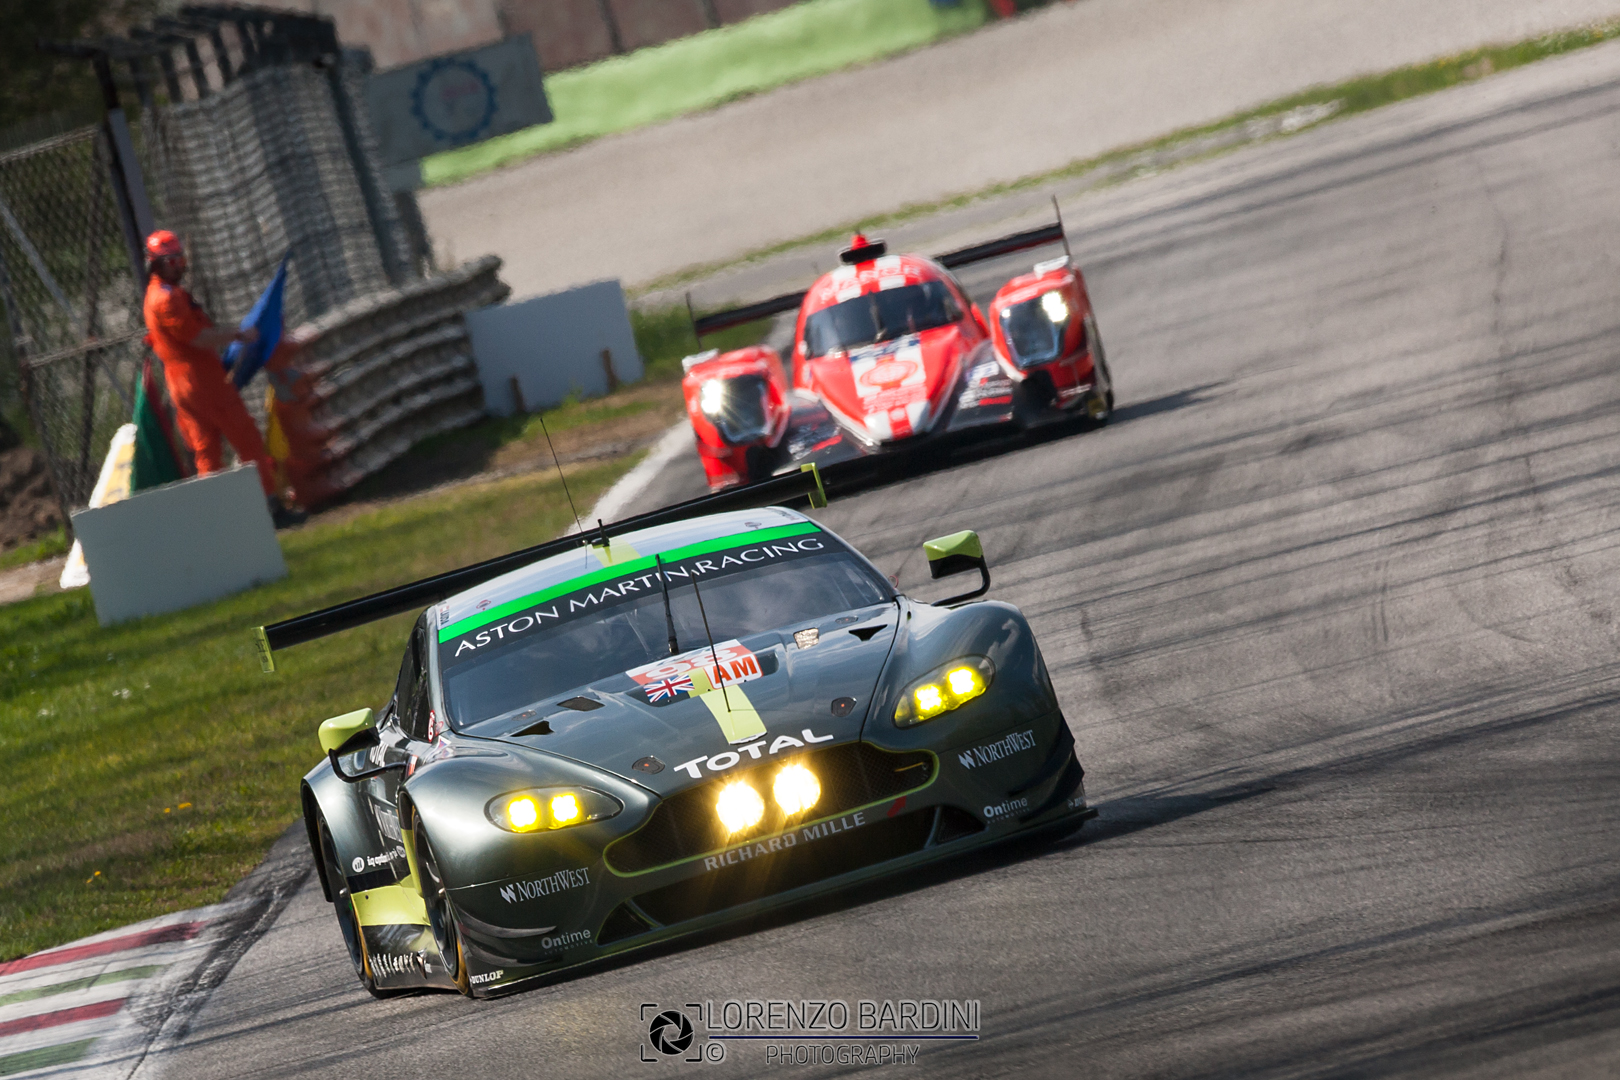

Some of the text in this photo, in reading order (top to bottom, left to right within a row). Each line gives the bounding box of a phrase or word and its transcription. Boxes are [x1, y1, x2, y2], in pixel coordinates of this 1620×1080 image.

[454, 538, 825, 658] ASTON MARTIN RACING
[645, 649, 738, 681] 98
[712, 656, 758, 685] AM
[673, 728, 835, 780] TOTAL
[983, 797, 1028, 818] Ontime
[703, 811, 866, 872] RICHARD MILLE
[541, 928, 592, 950] Ontime
